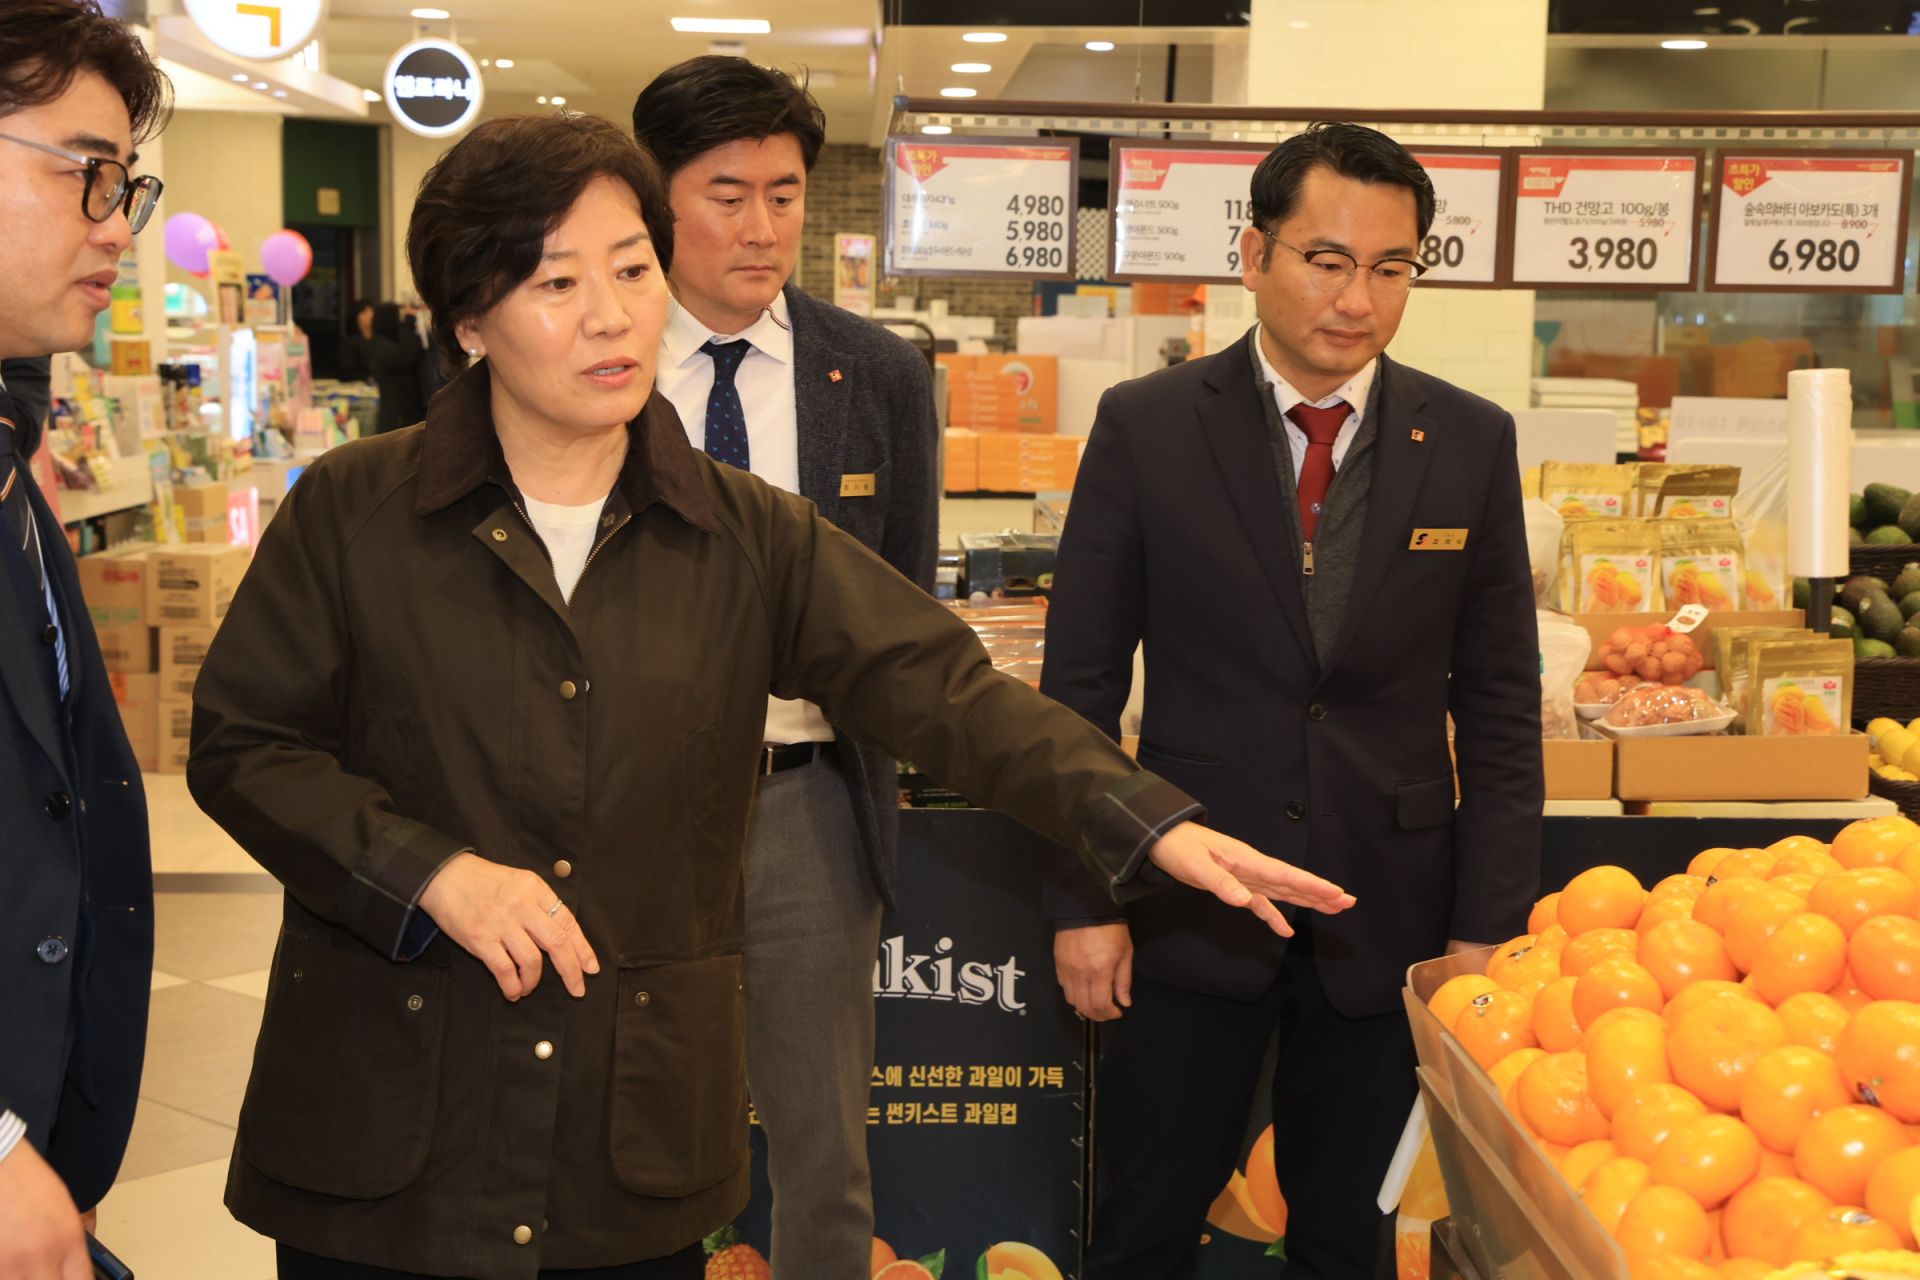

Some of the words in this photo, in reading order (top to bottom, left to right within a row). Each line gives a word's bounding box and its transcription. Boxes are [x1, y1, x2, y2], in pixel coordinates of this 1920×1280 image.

[1728, 163, 1761, 177] 초특가
[1732, 177, 1755, 191] 할인
[1006, 194, 1064, 216] 4,980
[1544, 201, 1571, 215] THD
[1575, 200, 1614, 216] 건망고
[1620, 201, 1670, 217] 100g/봉
[1744, 202, 1797, 218] 숲속의버터
[1861, 202, 1880, 218] 3개
[1006, 220, 1063, 242] 5,980
[1005, 246, 1062, 268] 6,980
[1568, 237, 1657, 272] 3,980
[1768, 238, 1861, 274] 6,980
[872, 935, 1027, 1013] kist
[870, 1065, 903, 1087] 스에
[908, 1065, 964, 1088] 신선한
[968, 1065, 1022, 1088] 과일이
[1028, 1066, 1065, 1088] 가득
[886, 1103, 959, 1125] 썬키스트
[963, 1103, 1018, 1125] 과일컵
